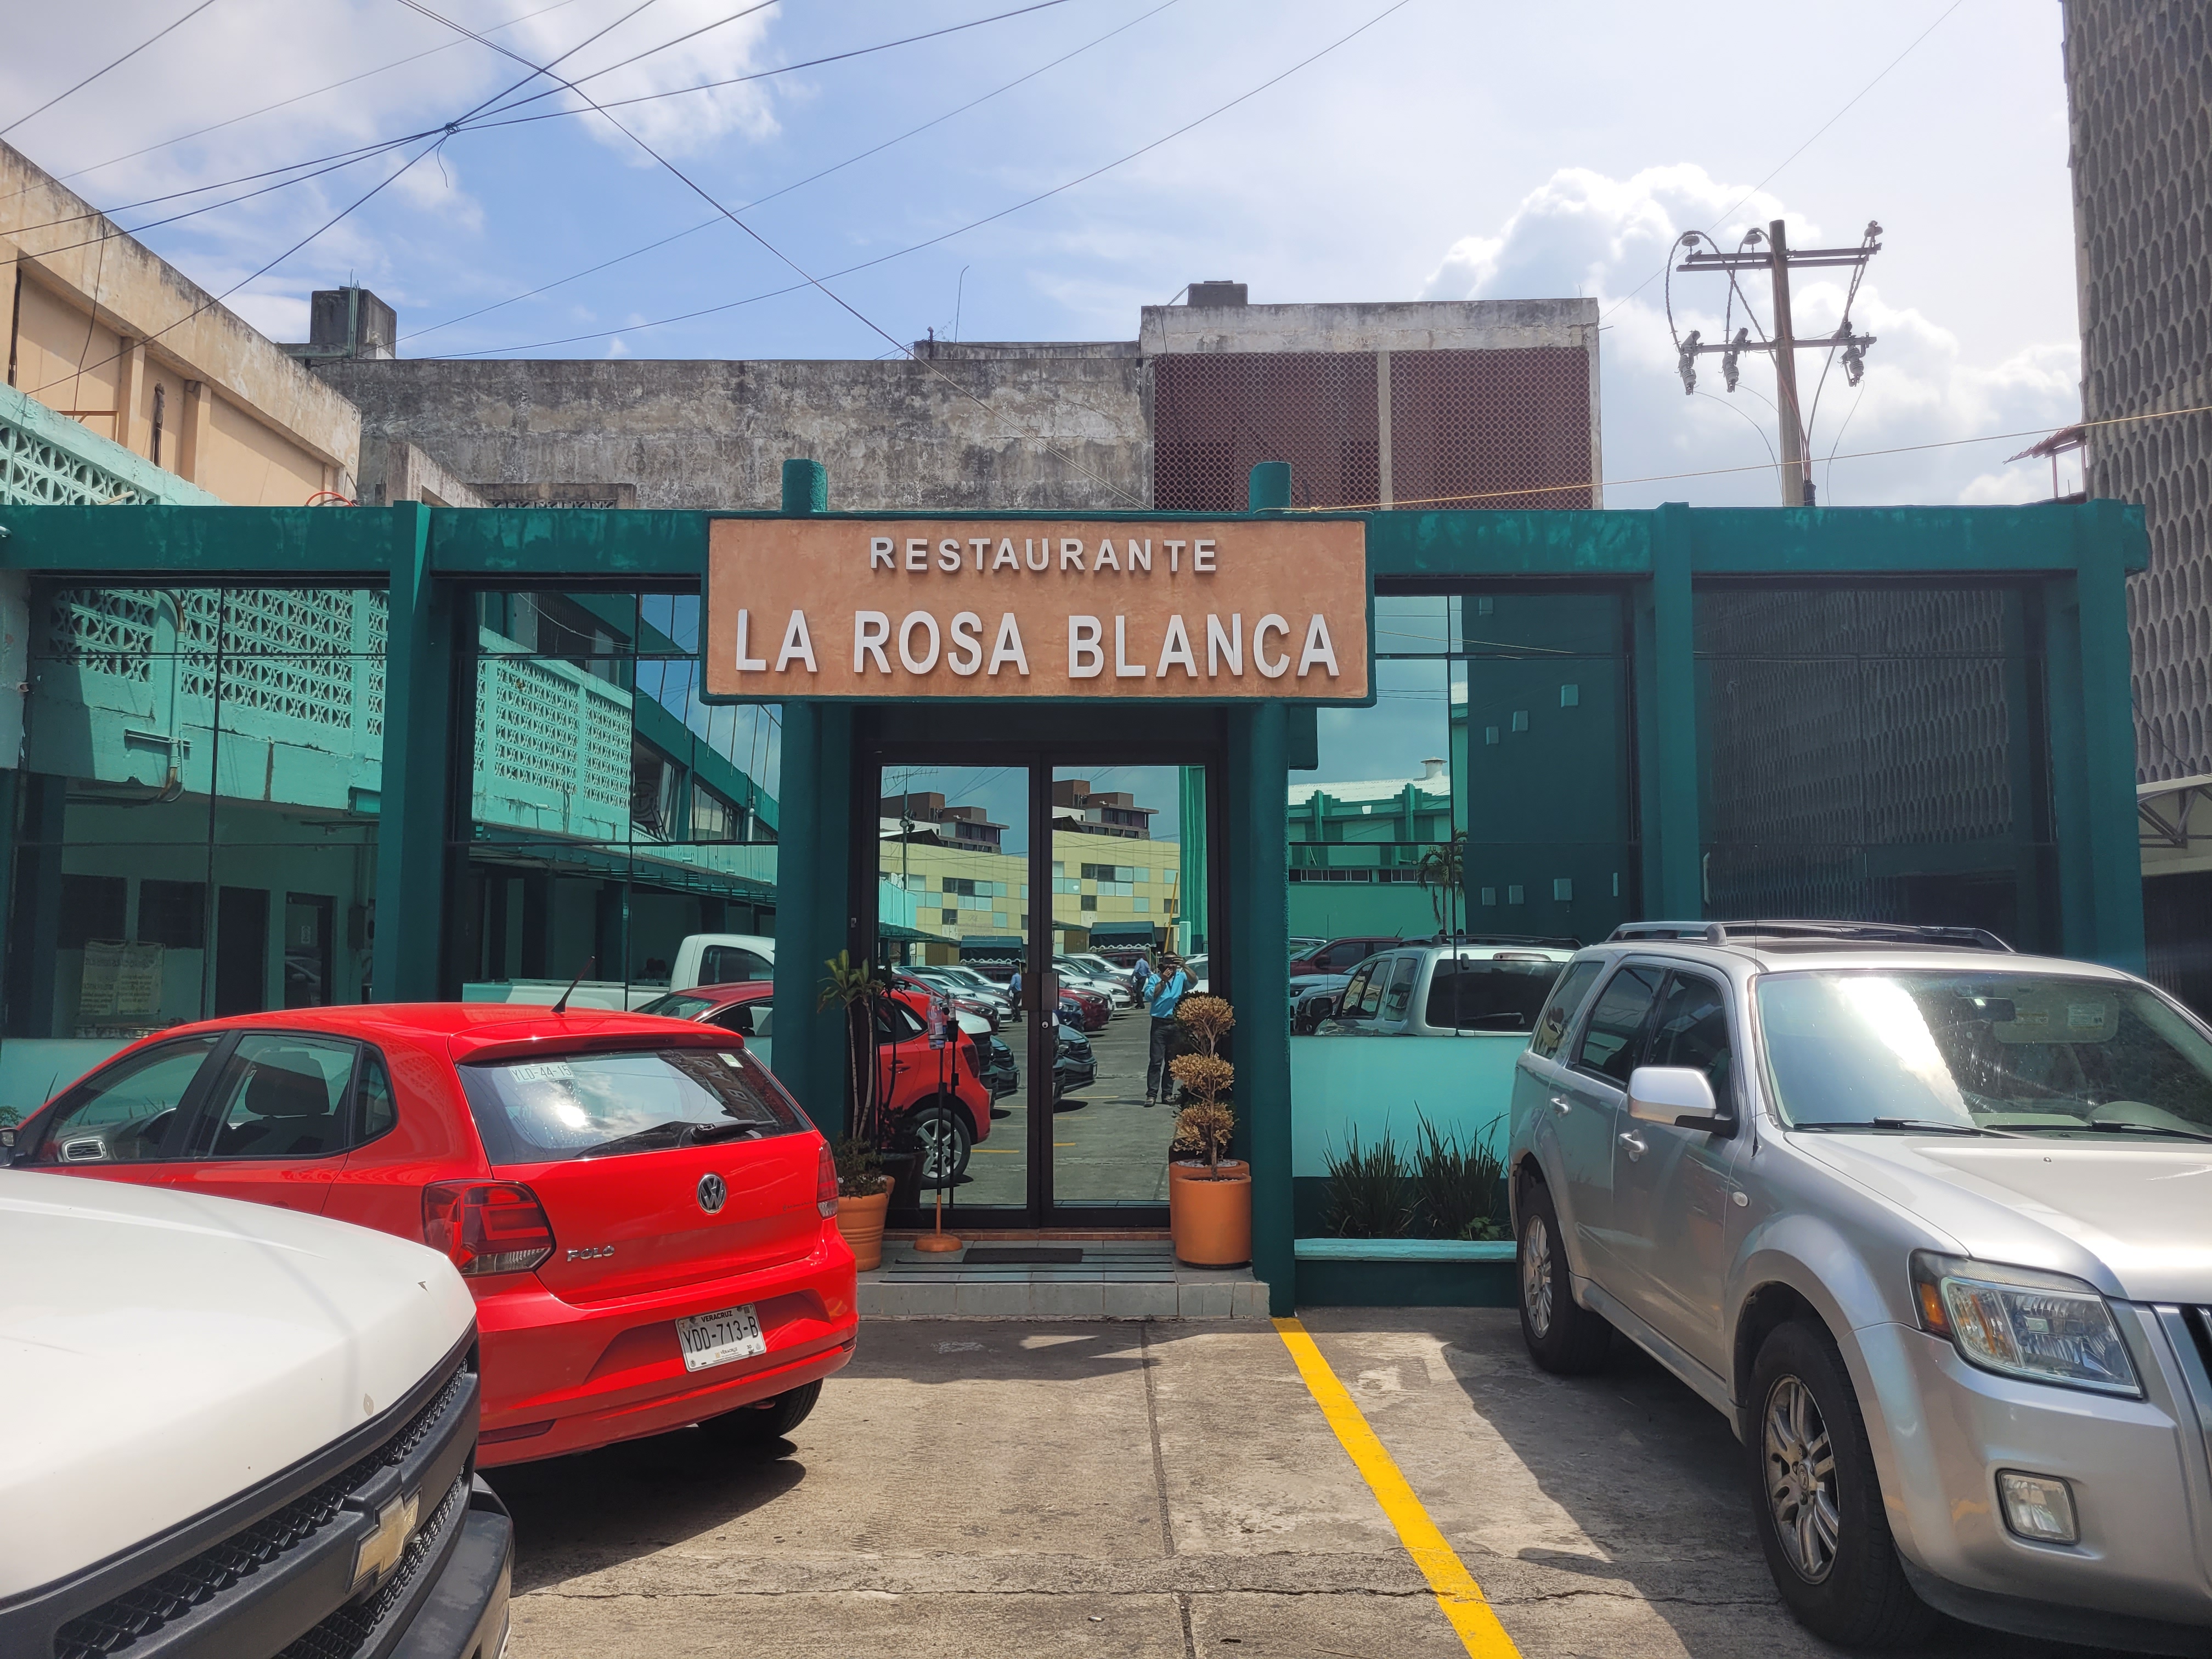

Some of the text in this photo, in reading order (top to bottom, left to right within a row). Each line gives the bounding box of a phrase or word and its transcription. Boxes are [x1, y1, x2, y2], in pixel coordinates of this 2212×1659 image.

[870, 537, 1216, 572] RESTAURANTE
[736, 608, 1340, 678] LA ROSA BLANCA
[511, 1065, 572, 1081] YLD-44-15
[567, 1244, 615, 1262] POLO
[701, 1310, 733, 1323] VERACRUZ
[683, 1316, 759, 1353] YDD-713-B
